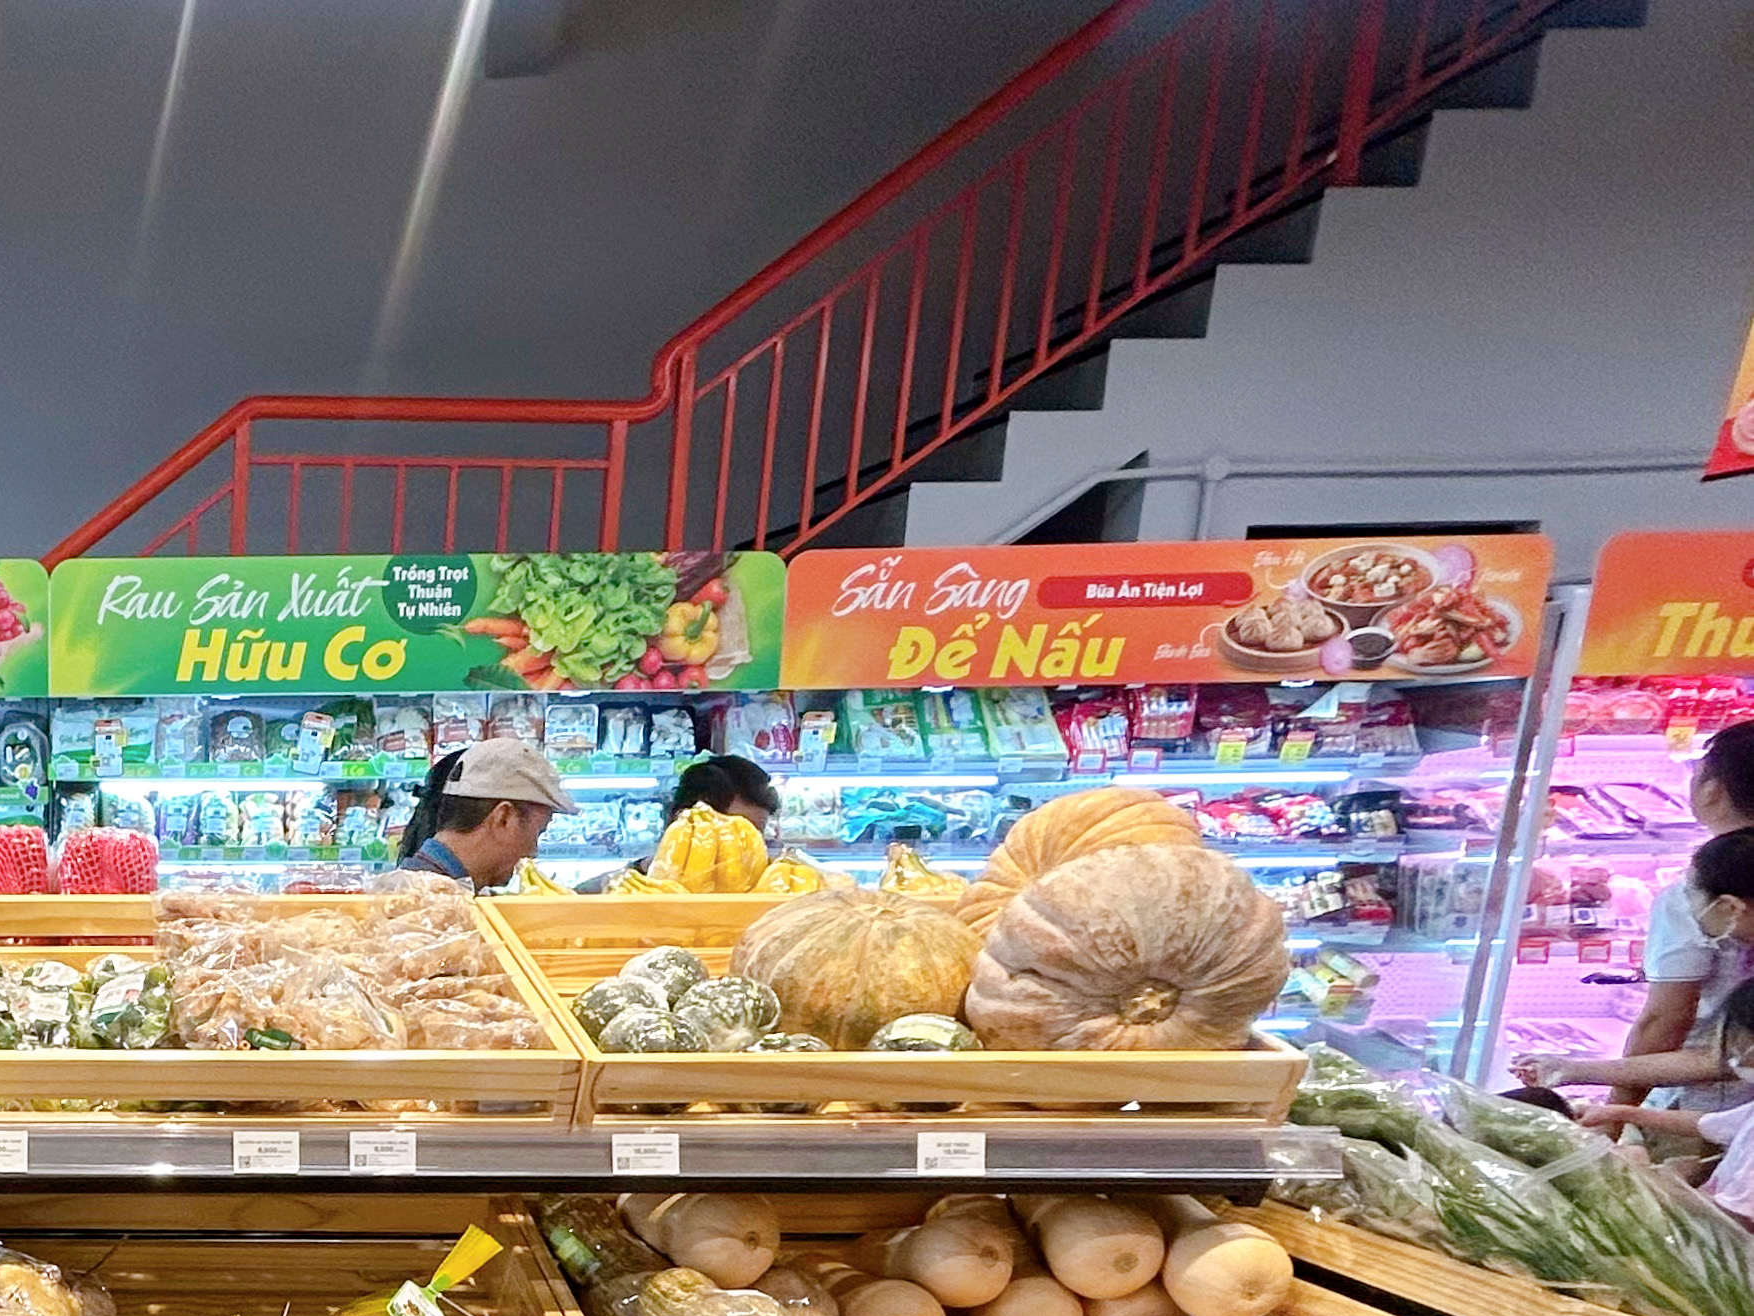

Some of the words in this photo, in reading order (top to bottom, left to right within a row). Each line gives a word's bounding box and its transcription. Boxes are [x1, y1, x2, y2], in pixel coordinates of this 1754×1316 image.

[408, 583, 452, 601] Thuận
[438, 565, 469, 584] Trọt
[832, 555, 916, 618] Sẵn
[923, 561, 1031, 620] Sàng
[1118, 579, 1140, 598] Ăn
[1143, 581, 1176, 599] Tiện
[97, 575, 184, 626] Rau
[189, 573, 266, 626] Sản
[277, 565, 390, 622] Xuất
[419, 602, 461, 618] Nhiên
[175, 625, 308, 684] Hữu
[323, 625, 408, 682] Cơ
[886, 612, 990, 680] Để
[989, 612, 1126, 679] Nấu
